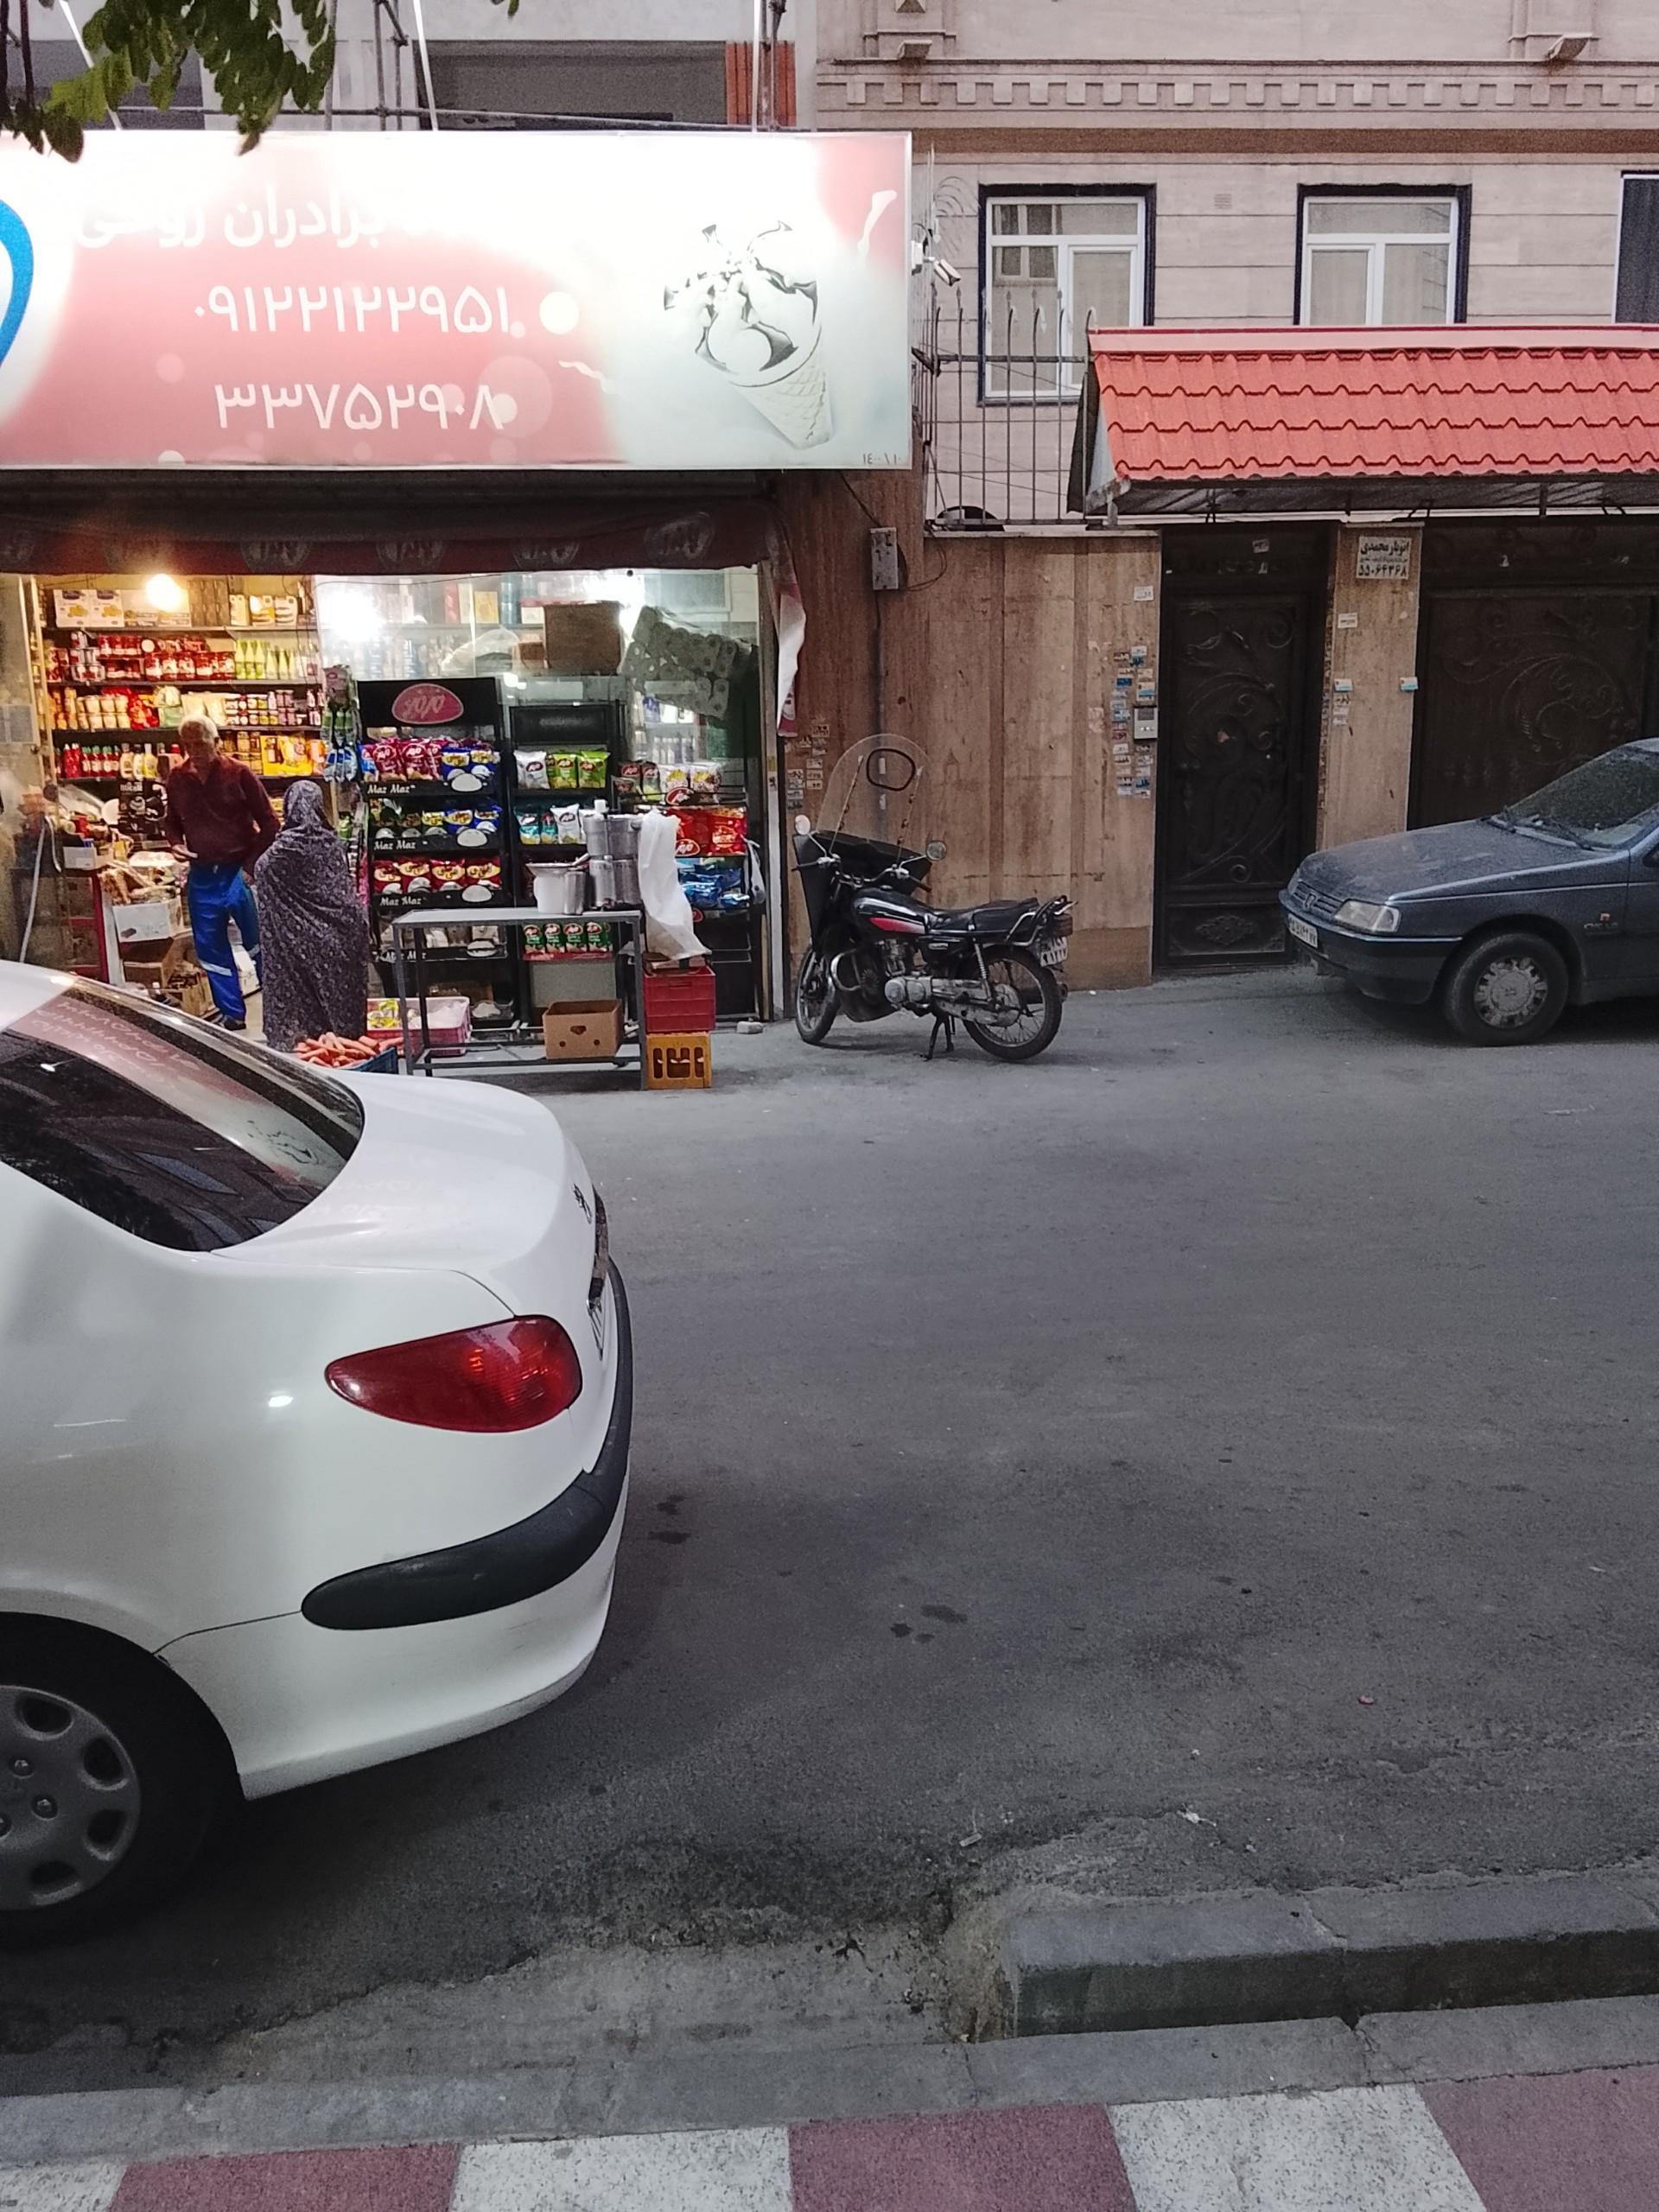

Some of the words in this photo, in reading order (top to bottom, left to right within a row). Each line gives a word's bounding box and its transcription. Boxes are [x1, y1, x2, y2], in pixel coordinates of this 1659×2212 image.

[224, 182, 385, 249] برادران
[194, 285, 510, 334] ۰۹۱۲۲۱۲۲۹۵۱
[214, 382, 505, 430] ۳۳۷۵۲۹۰۸
[367, 785, 386, 794] Maz
[390, 784, 410, 793] Maz
[373, 841, 393, 850] Maz
[396, 840, 416, 849] Maz
[380, 897, 399, 906] Maz
[402, 896, 422, 905] Maz
